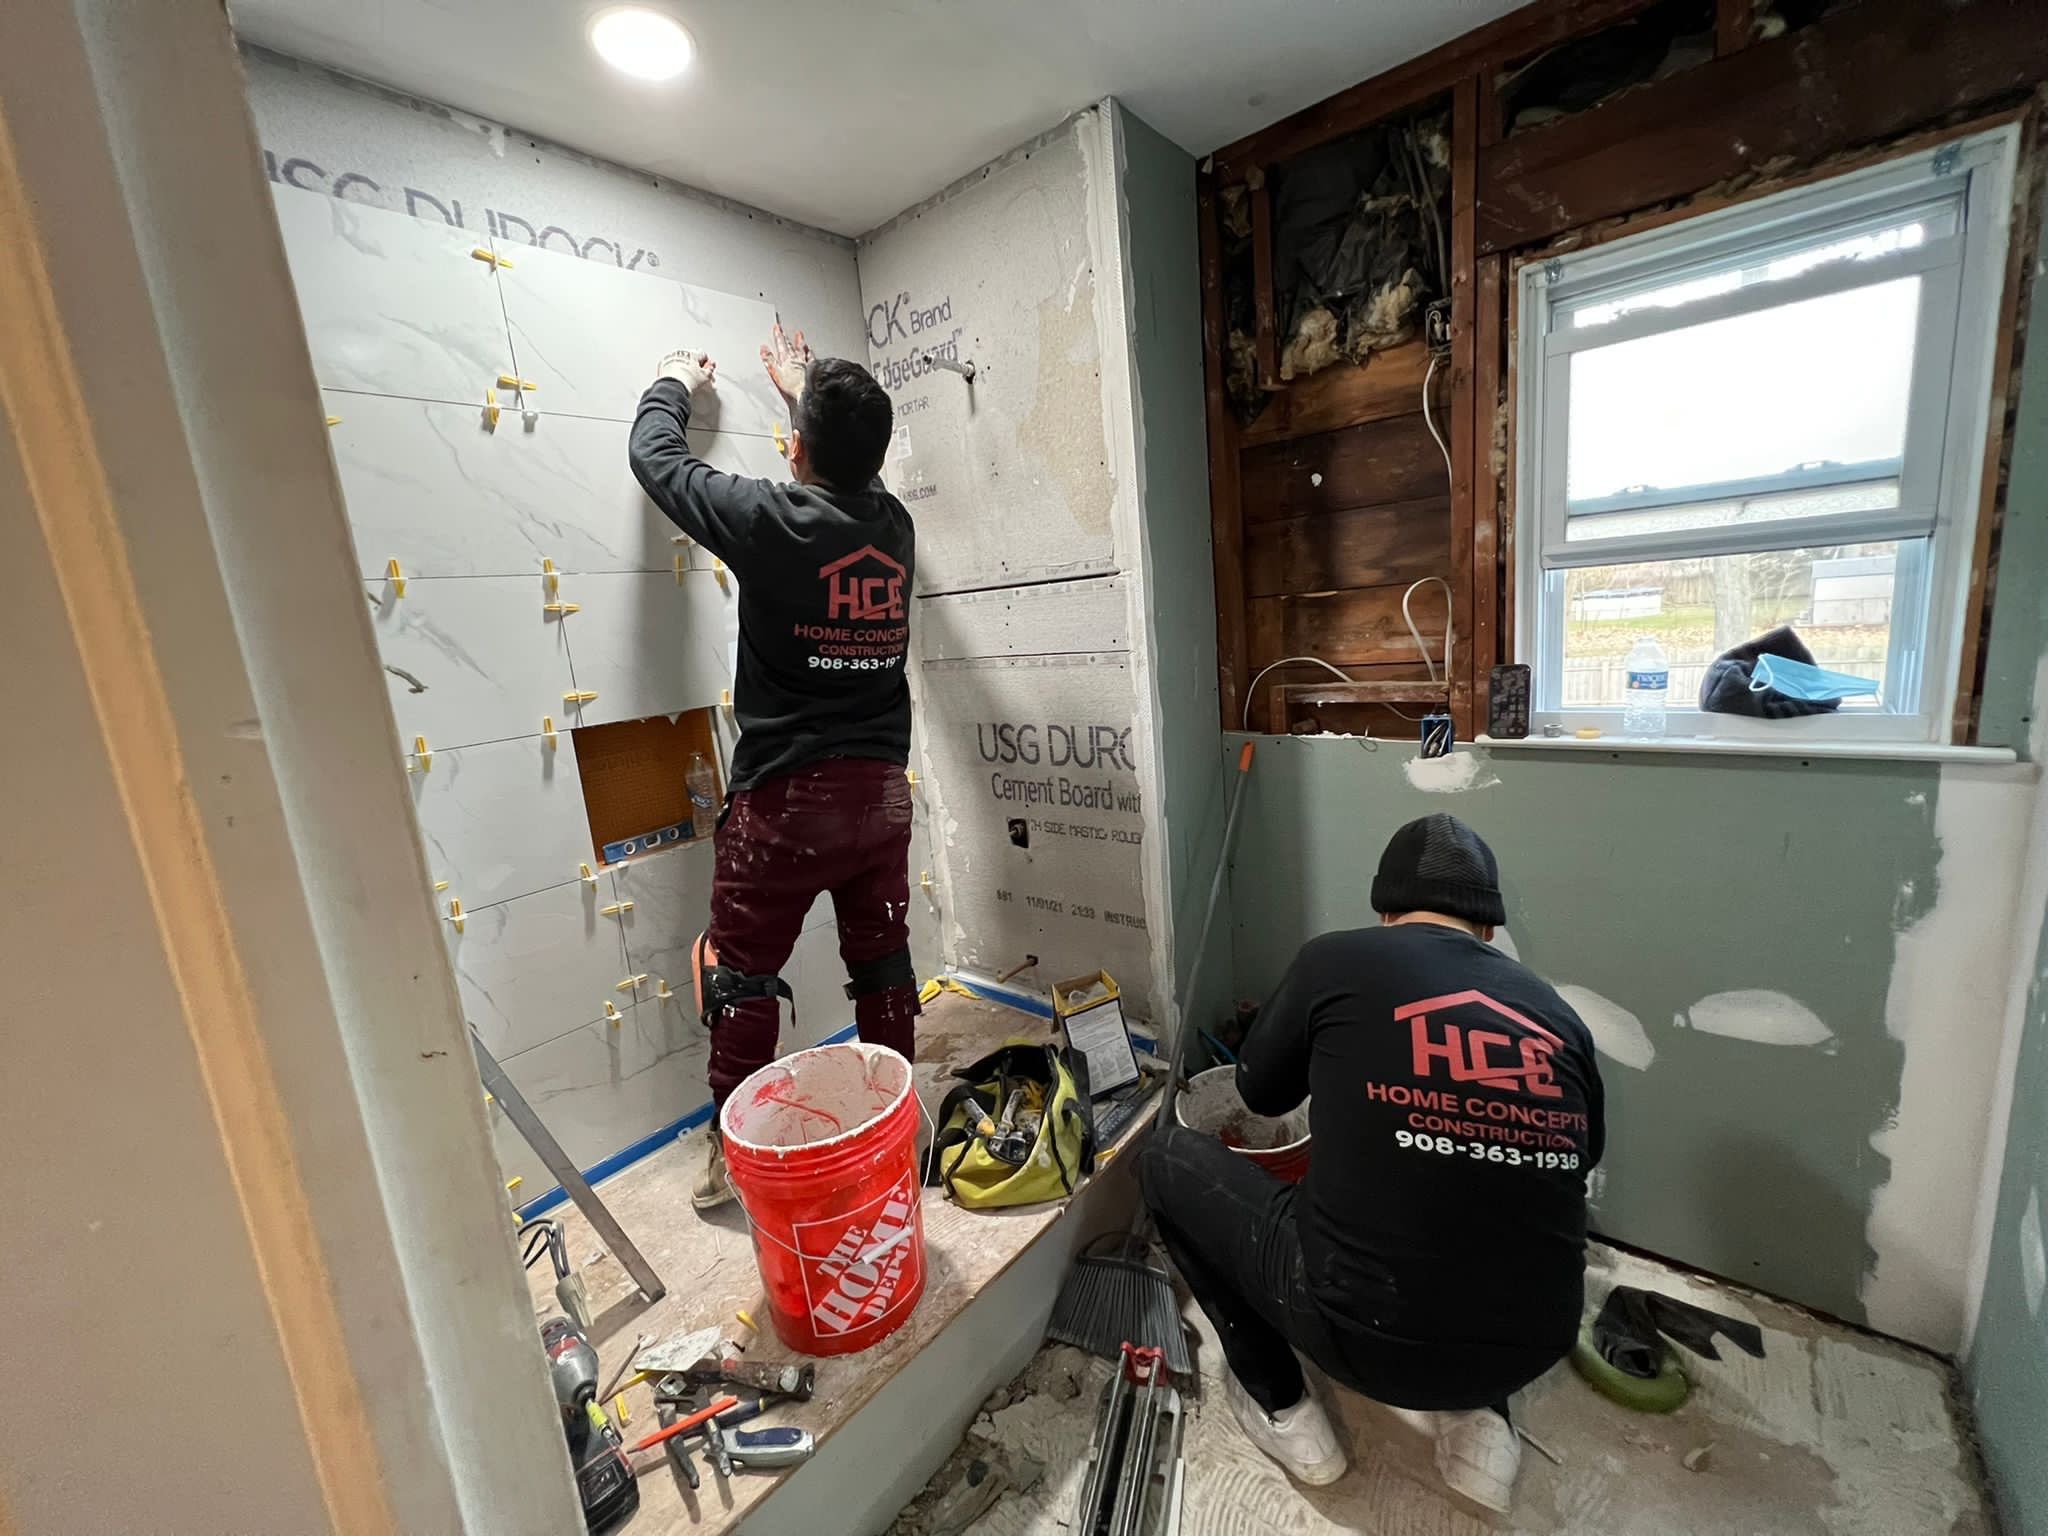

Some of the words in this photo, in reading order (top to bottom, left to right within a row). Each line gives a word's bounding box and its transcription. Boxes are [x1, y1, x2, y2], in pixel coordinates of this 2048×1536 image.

[910, 296, 952, 335] Brand
[794, 623, 850, 642] HOME
[808, 655, 900, 670] 908-363-19
[977, 723, 1041, 765] USG
[992, 772, 1055, 806] Cement
[1059, 777, 1113, 810] Board
[1366, 1081, 1459, 1113] HOME
[1465, 1098, 1588, 1132] CONCEPTS
[1394, 1130, 1579, 1171] 908-363-1938
[1408, 1112, 1577, 1150] CONSTRUCTION
[816, 1225, 868, 1279] THE
[863, 1220, 912, 1319] DEPO
